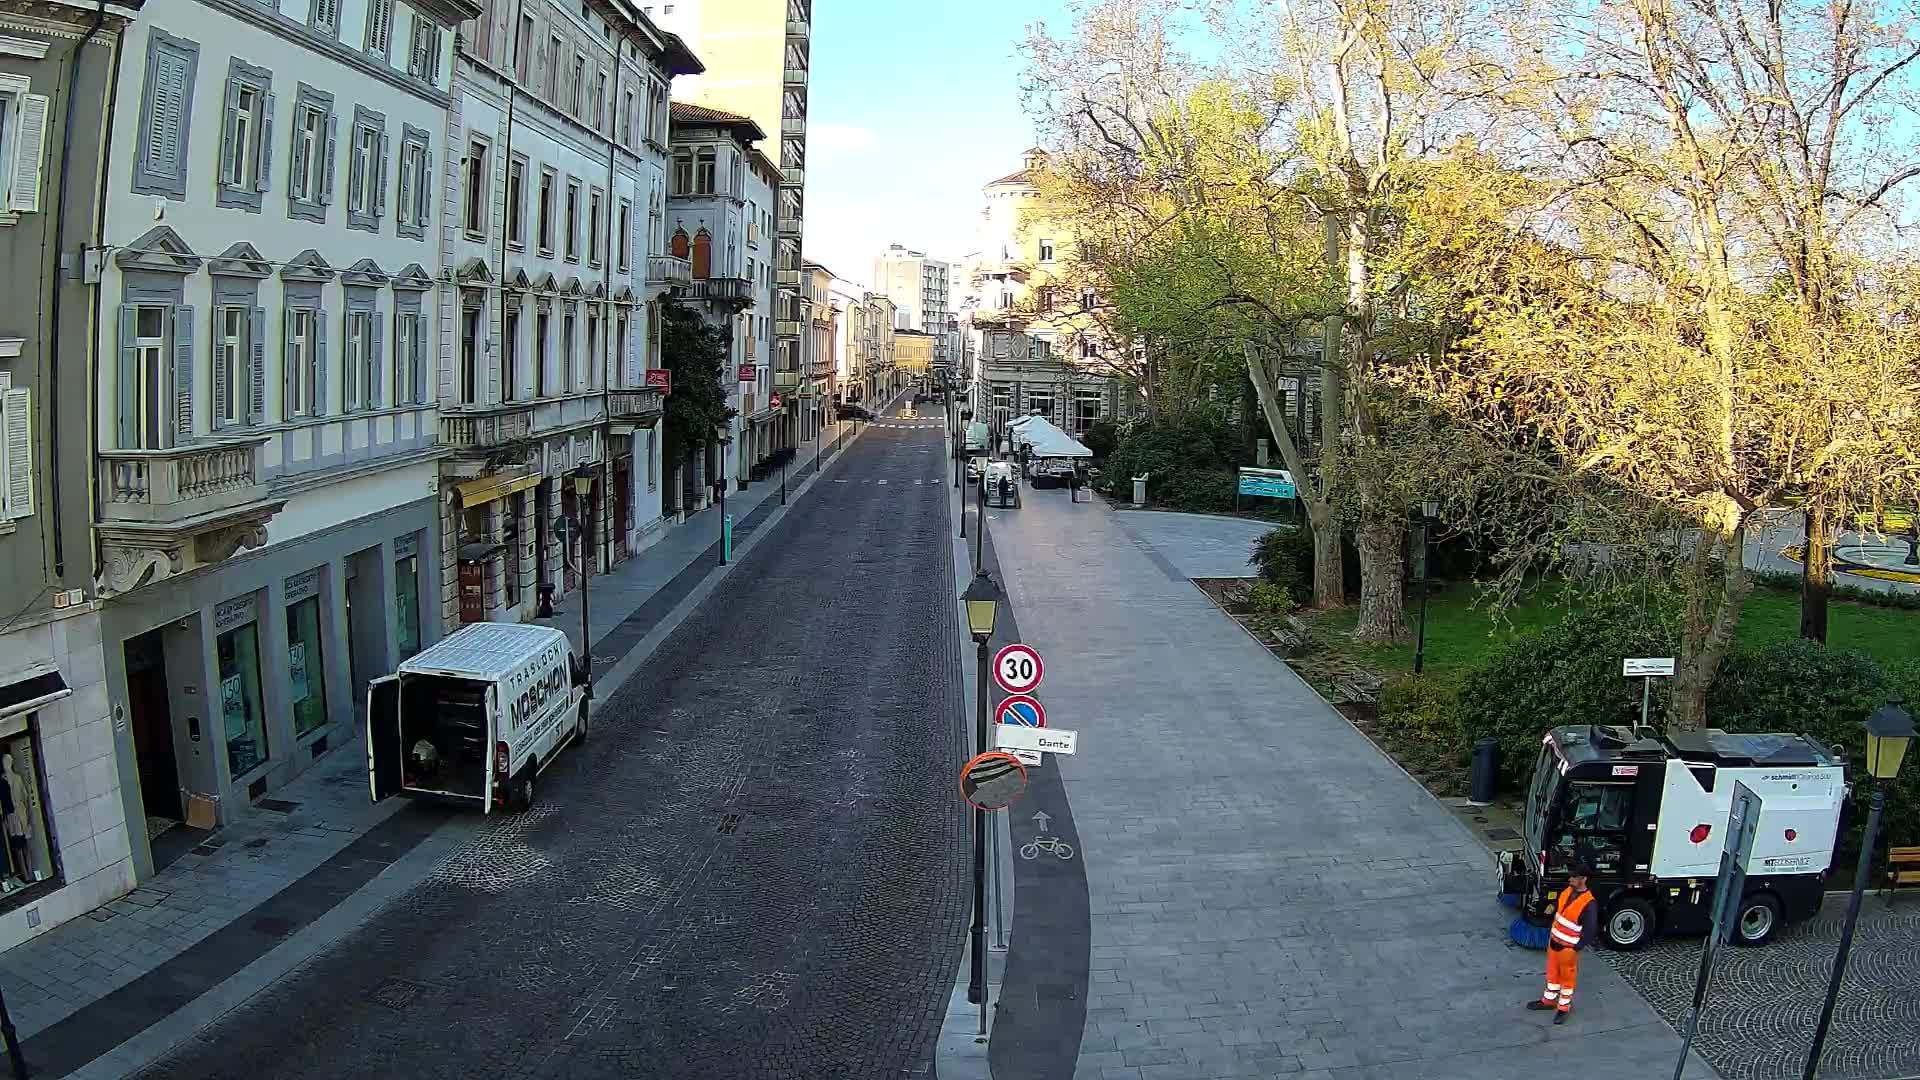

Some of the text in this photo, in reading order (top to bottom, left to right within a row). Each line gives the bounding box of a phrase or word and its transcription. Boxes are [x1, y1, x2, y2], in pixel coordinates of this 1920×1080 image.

[509, 641, 563, 690] TRASLOCHI
[1006, 658, 1033, 680] 30
[510, 661, 568, 732] MOSCHION
[1038, 738, 1070, 749] Dante
